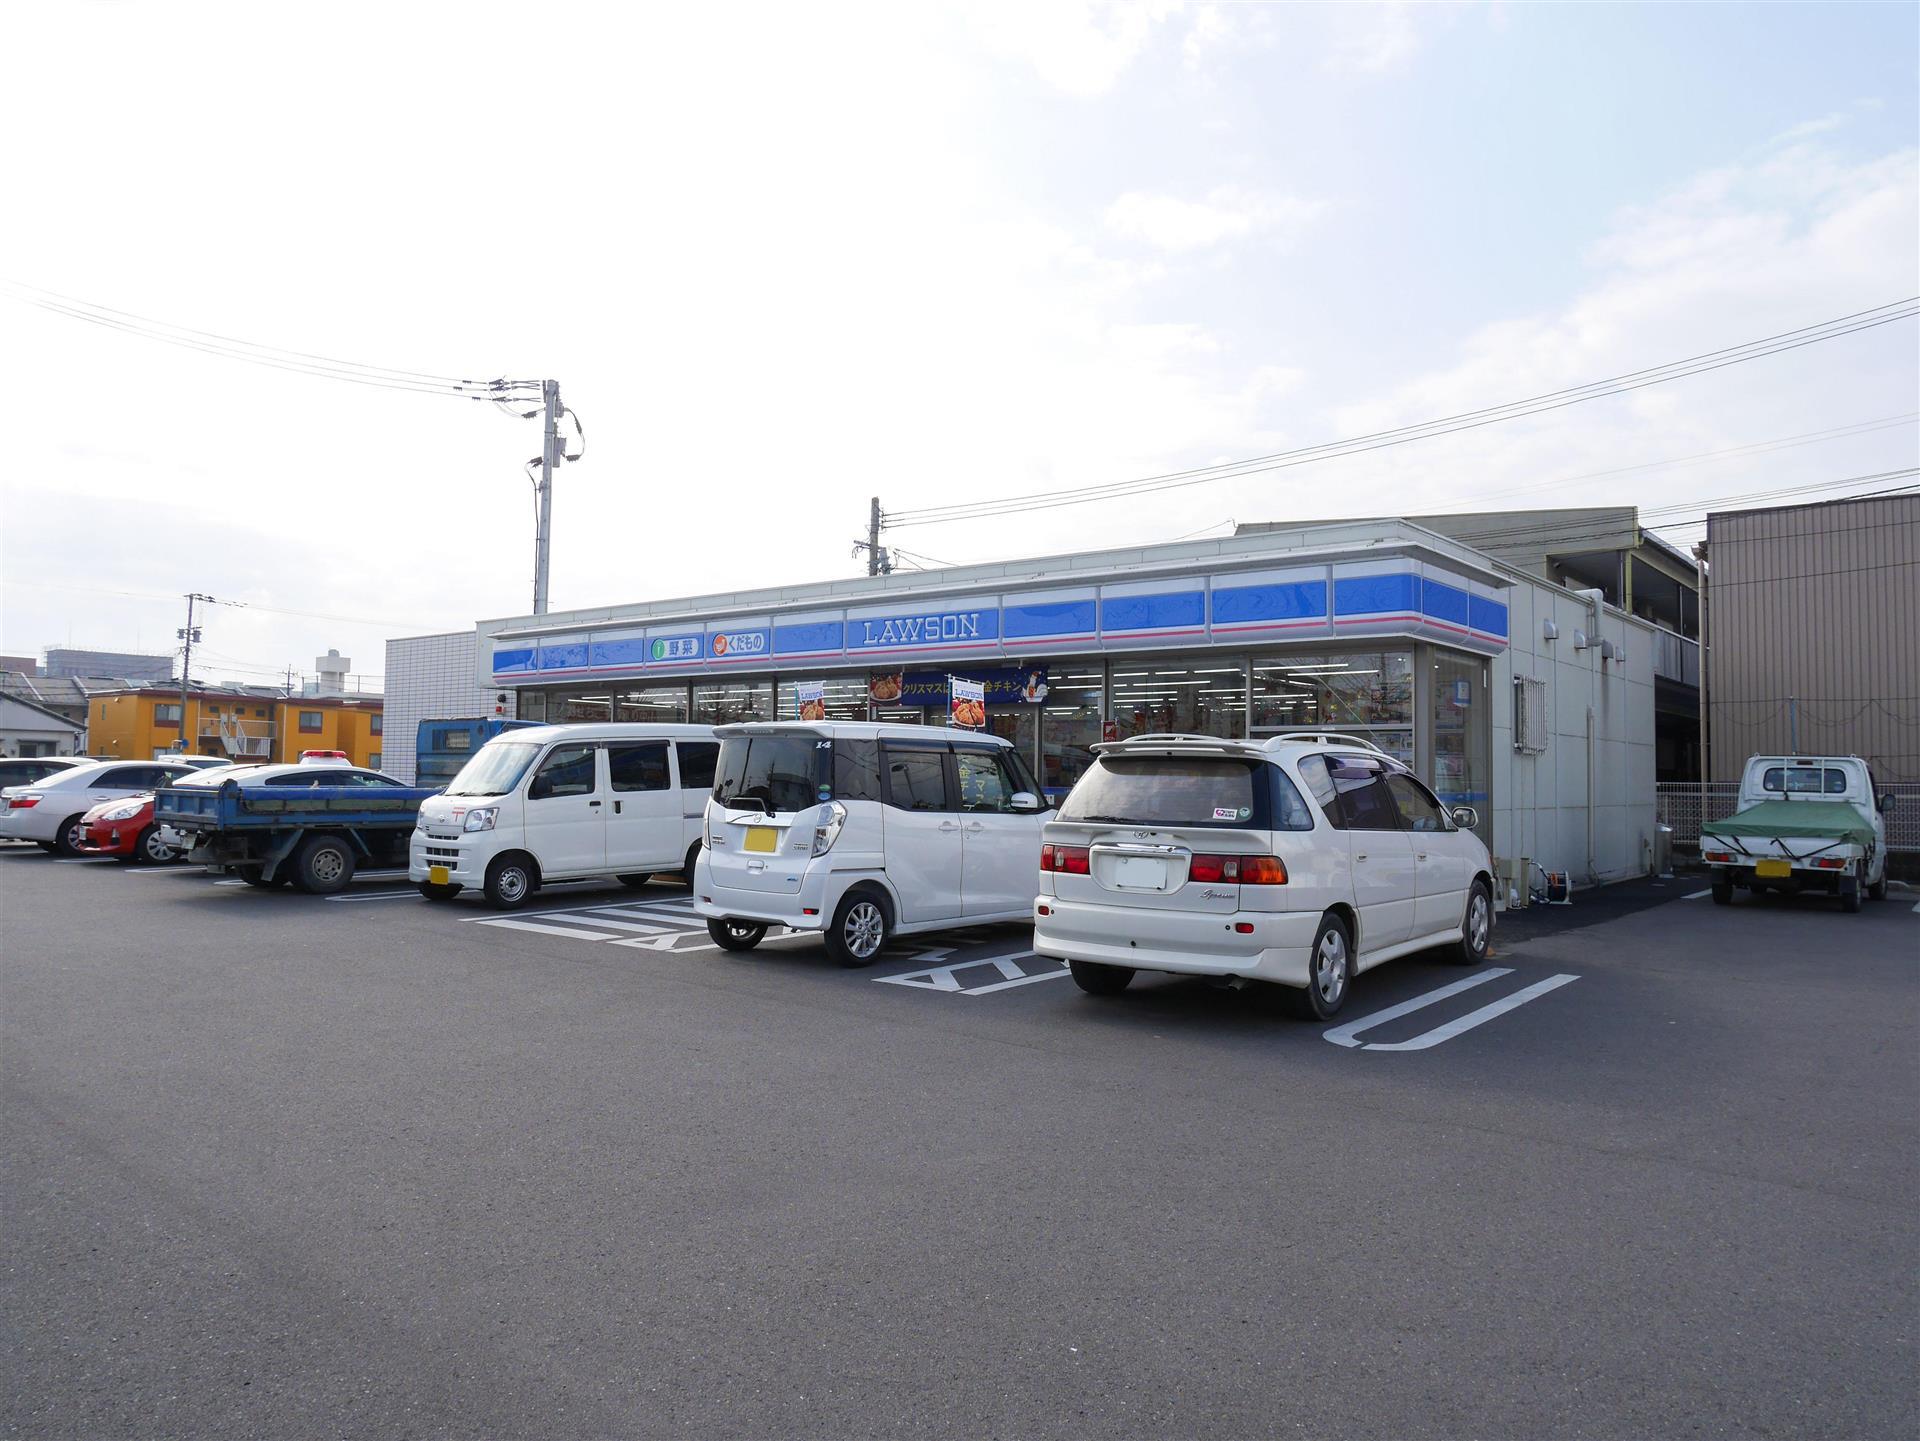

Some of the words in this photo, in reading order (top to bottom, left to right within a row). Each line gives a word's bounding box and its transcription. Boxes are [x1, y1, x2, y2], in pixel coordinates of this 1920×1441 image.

[863, 613, 979, 644] LAWSON
[668, 639, 693, 656] 野菜
[728, 634, 762, 652] くだもの
[955, 688, 983, 699] LAWSON
[815, 741, 832, 749] 14
